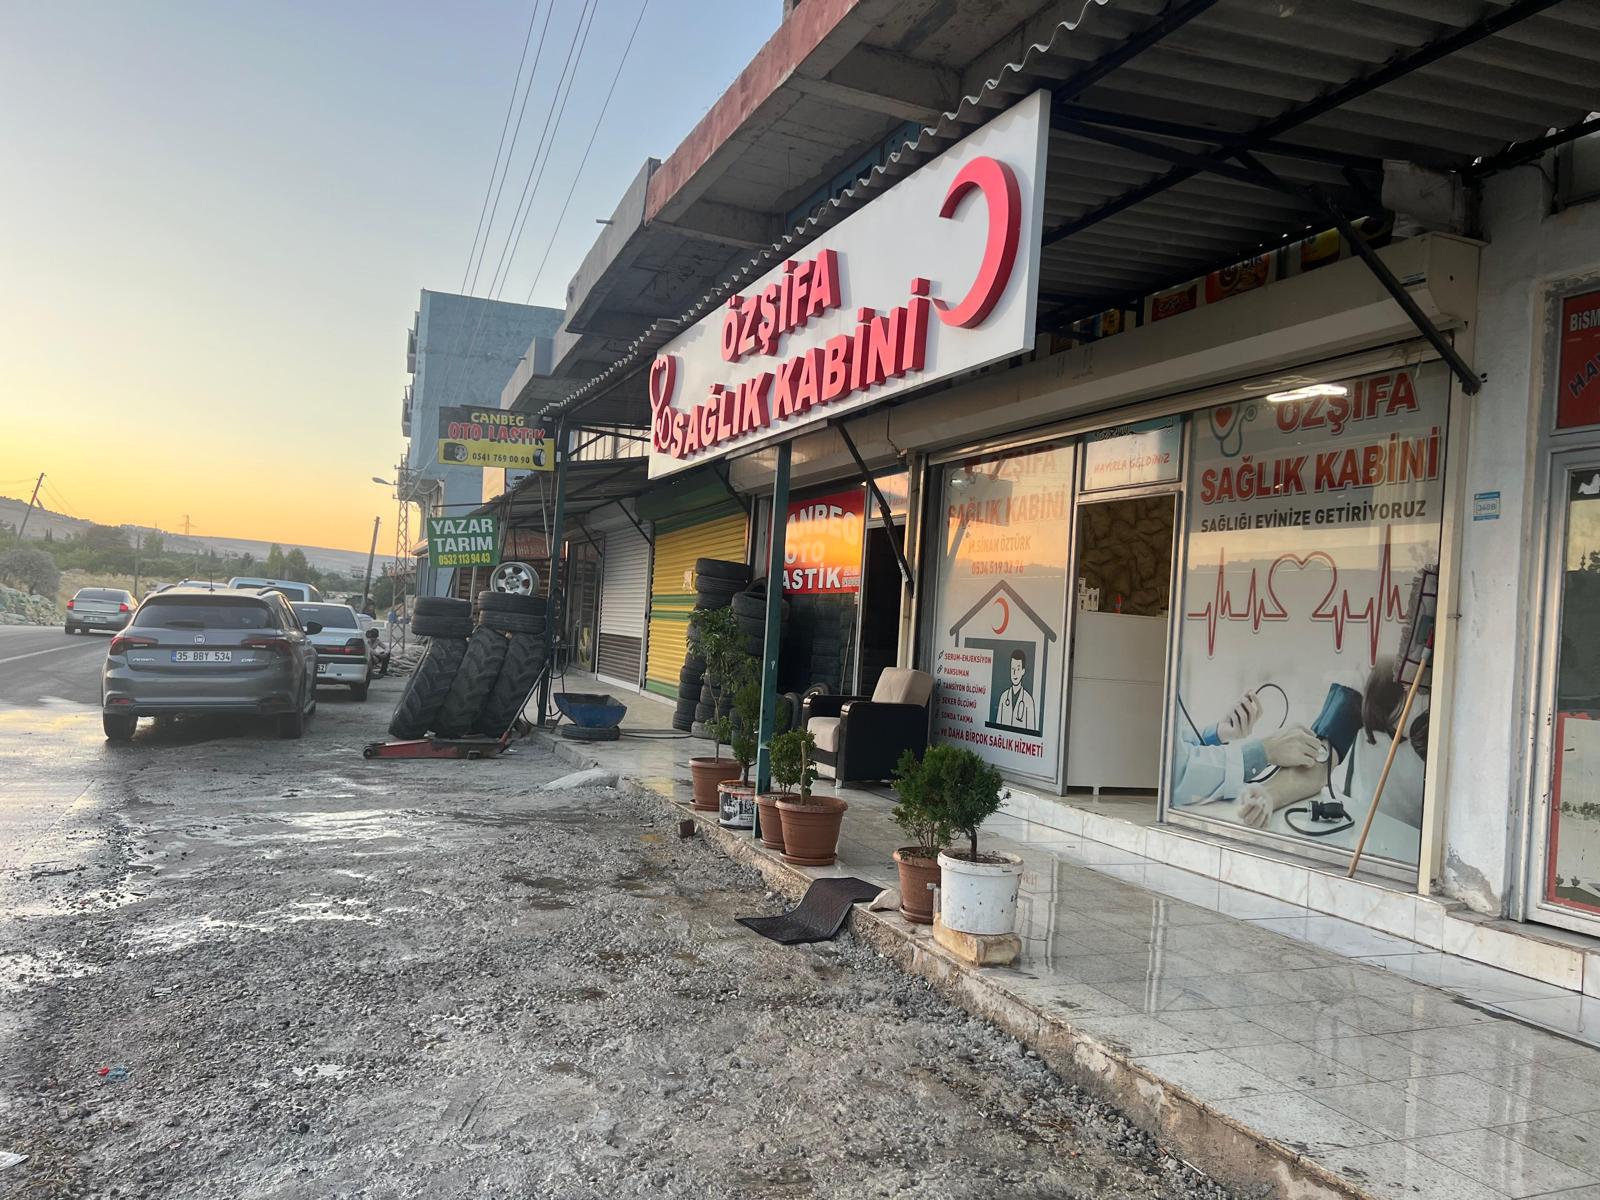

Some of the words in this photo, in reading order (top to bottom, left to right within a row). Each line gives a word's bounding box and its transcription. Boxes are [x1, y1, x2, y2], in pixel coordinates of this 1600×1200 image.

[721, 248, 841, 363] ÖZŞİFA
[670, 372, 775, 459] SAĞLIK
[772, 277, 930, 421] KABİNİ
[471, 412, 524, 427] CANBEG
[448, 422, 482, 441] OTO
[472, 453, 490, 461] 0541
[1200, 455, 1307, 505] SAĞLIK
[1314, 427, 1441, 493] KABİNİ
[788, 504, 859, 546] ANBEG
[1201, 513, 1252, 533] SAĞLIĞI
[1256, 507, 1311, 529] EVİNİZE
[1315, 500, 1426, 524] GETİRİYORUZ
[431, 518, 493, 535] YAZAR
[433, 536, 493, 553] TARIM
[785, 540, 826, 565] OTO
[438, 554, 458, 566] 0532
[458, 553, 471, 564] 113
[471, 552, 481, 564] 94
[177, 652, 188, 661] 35
[215, 652, 231, 661] 534
[943, 667, 970, 677] PANSUMAN
[948, 727, 964, 742] DAHA
[965, 728, 988, 747] BİRÇOK
[989, 735, 1013, 751] SAĞLIK
[1014, 738, 1044, 758] HİZMETİ
